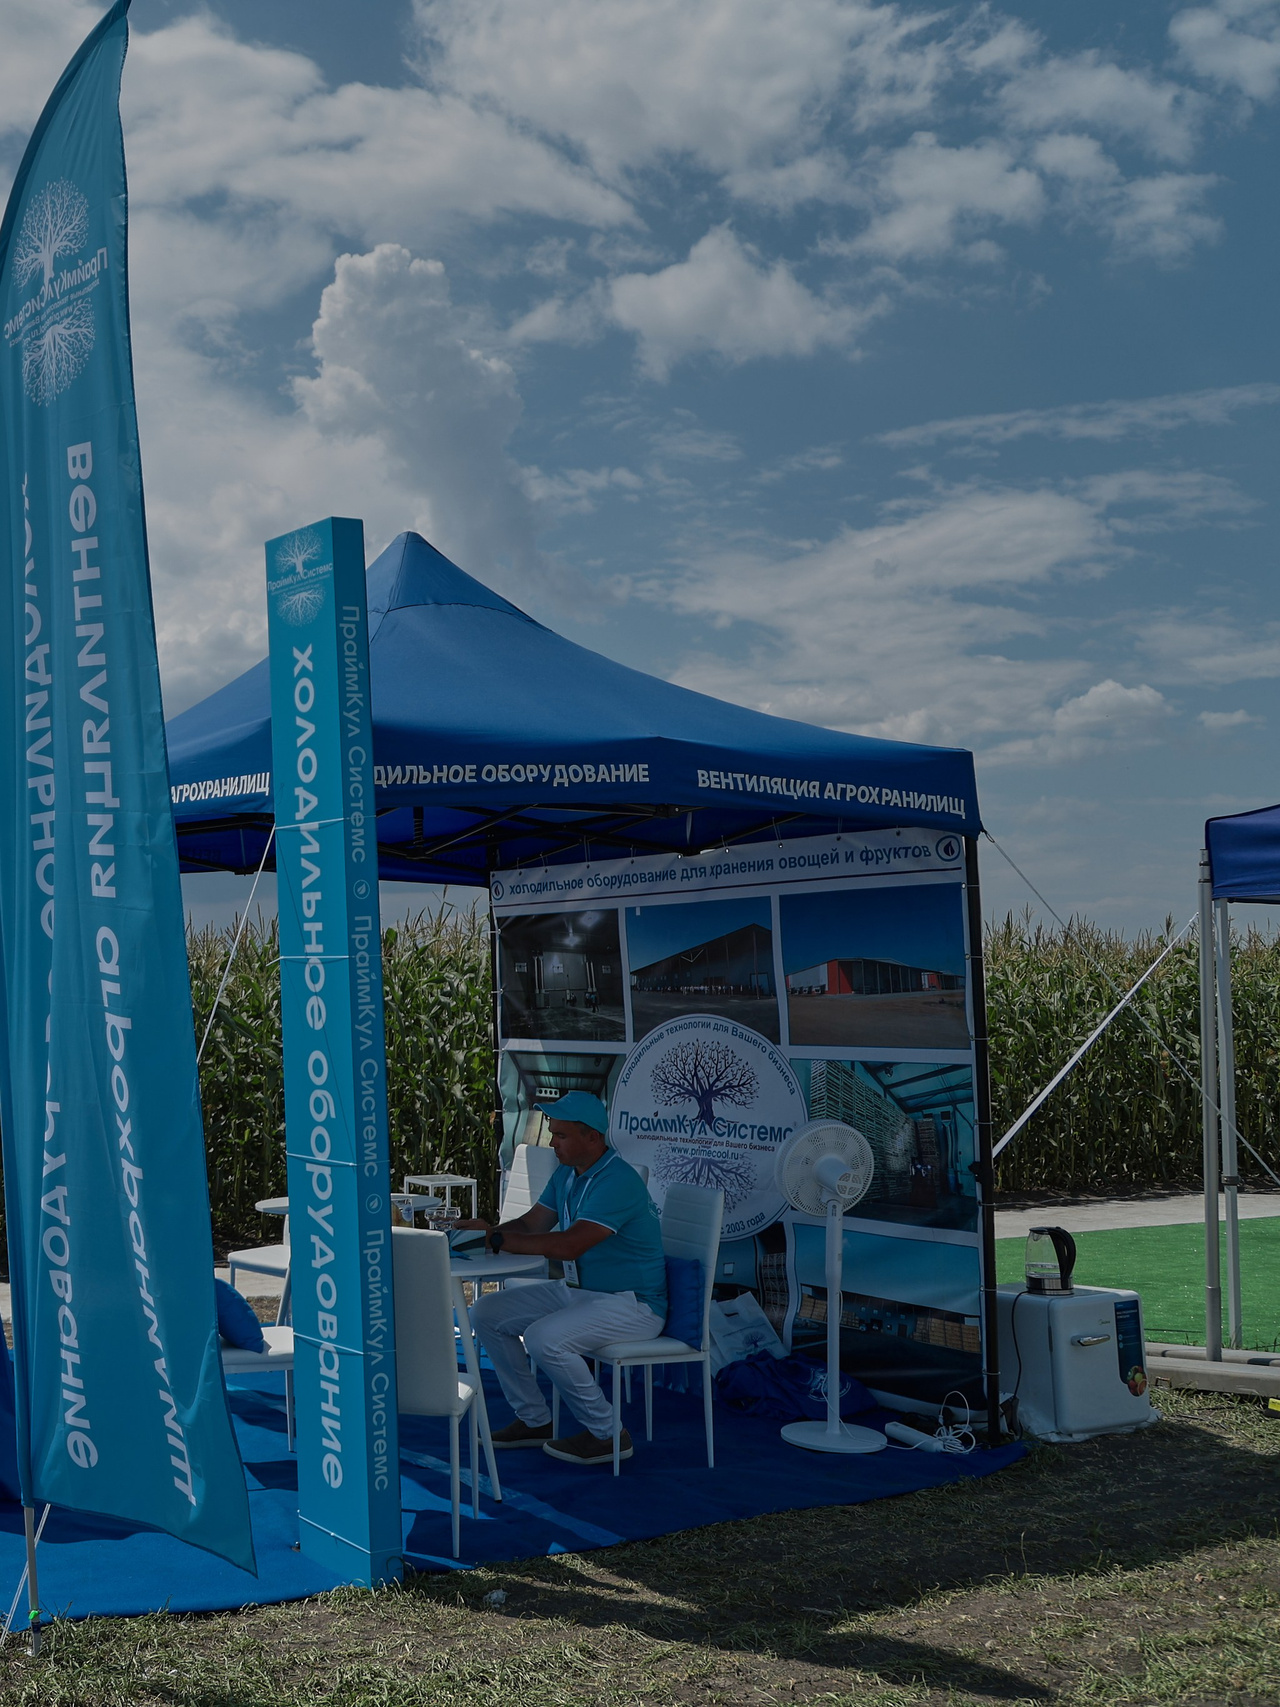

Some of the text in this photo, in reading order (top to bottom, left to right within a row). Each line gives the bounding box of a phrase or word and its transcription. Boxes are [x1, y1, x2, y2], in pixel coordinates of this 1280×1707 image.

[340, 605, 368, 863] ПраймКул Системс
[171, 771, 271, 803] АГРОХРАНИЛИЩ
[482, 763, 650, 787] ОБОРУДОВАНИЕ
[696, 769, 966, 819] ВЕНТИЛЯЦИЯ АГРОХРАНИЛИЩ
[509, 843, 932, 896] холодильное оборудование для хранения овощей и фруктов
[292, 643, 345, 1490] холодильное оборудование
[351, 915, 380, 1177] ПраймКул Системс
[621, 1021, 797, 1096] Холодильные технологии для Вашего бизнеса
[618, 1111, 794, 1143] ПраймКул Системс
[636, 1134, 776, 1152] холодильные технологии для Вашего бизнеса
[669, 1146, 740, 1160] www.primecool.ru
[725, 1221, 745, 1235] 2003
[746, 1212, 766, 1229] года
[363, 1229, 391, 1491] ПраймКул Системс
